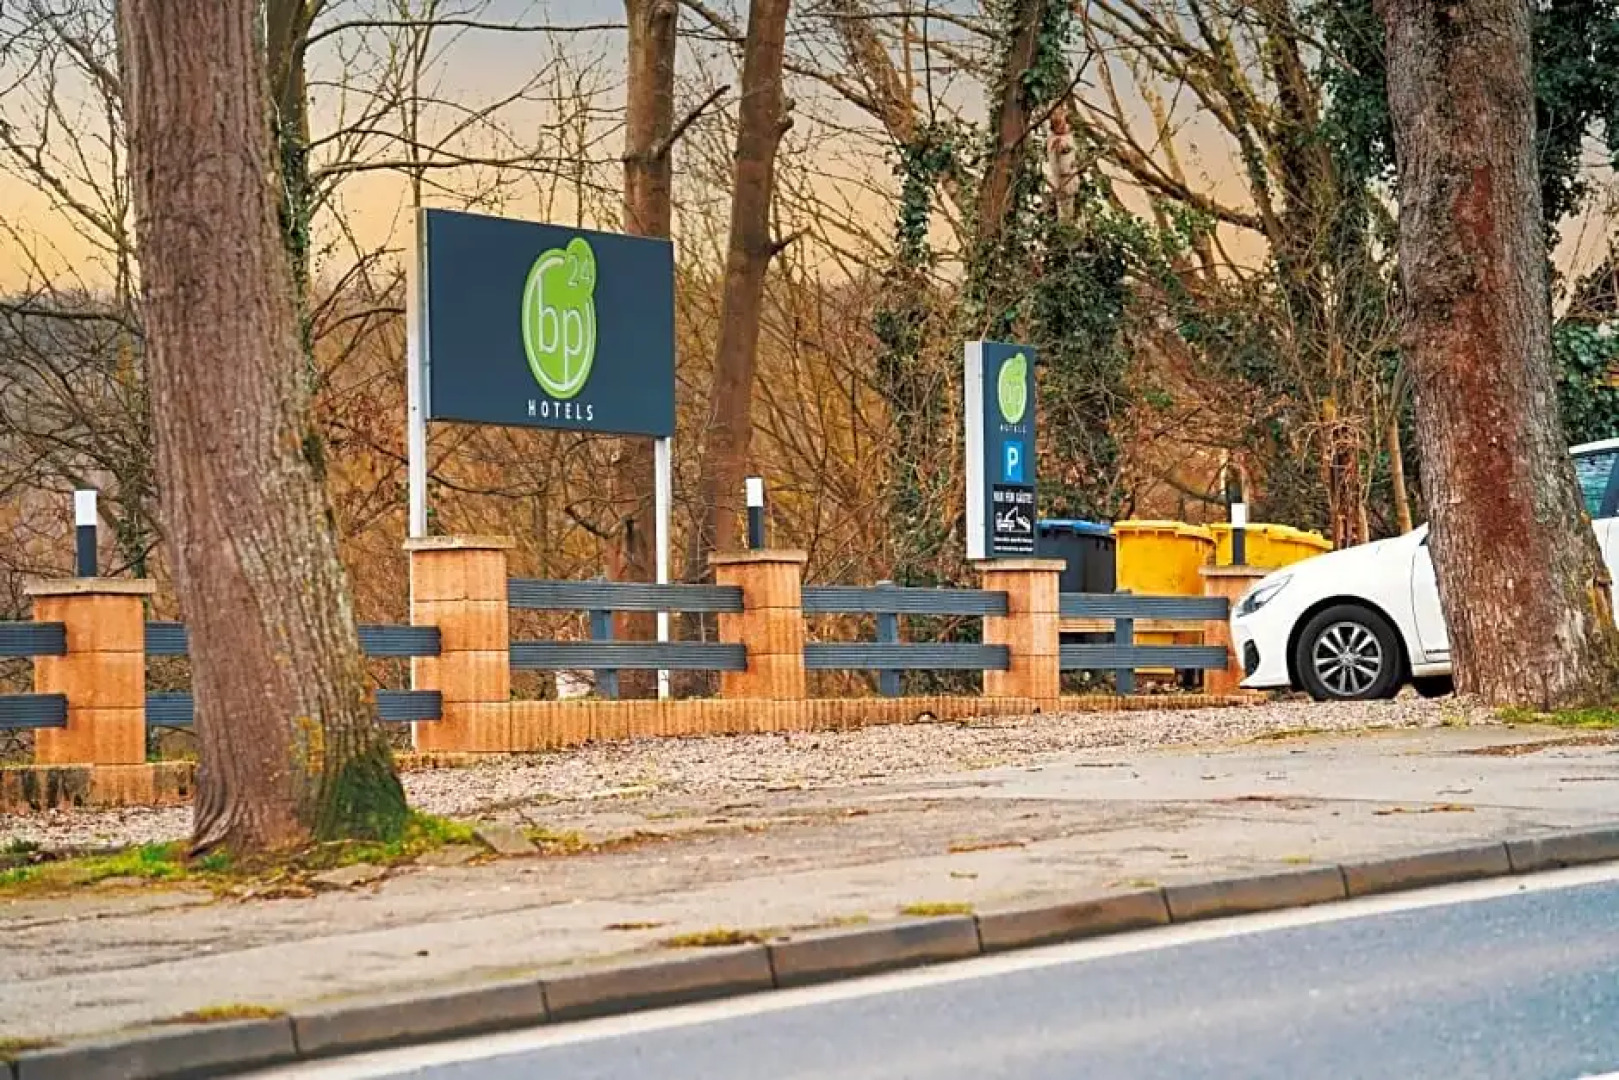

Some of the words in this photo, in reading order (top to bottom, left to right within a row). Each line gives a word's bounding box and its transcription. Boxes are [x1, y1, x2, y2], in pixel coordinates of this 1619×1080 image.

[567, 254, 593, 287] 24
[528, 399, 594, 422] HOTELS
[1006, 447, 1019, 476] P
